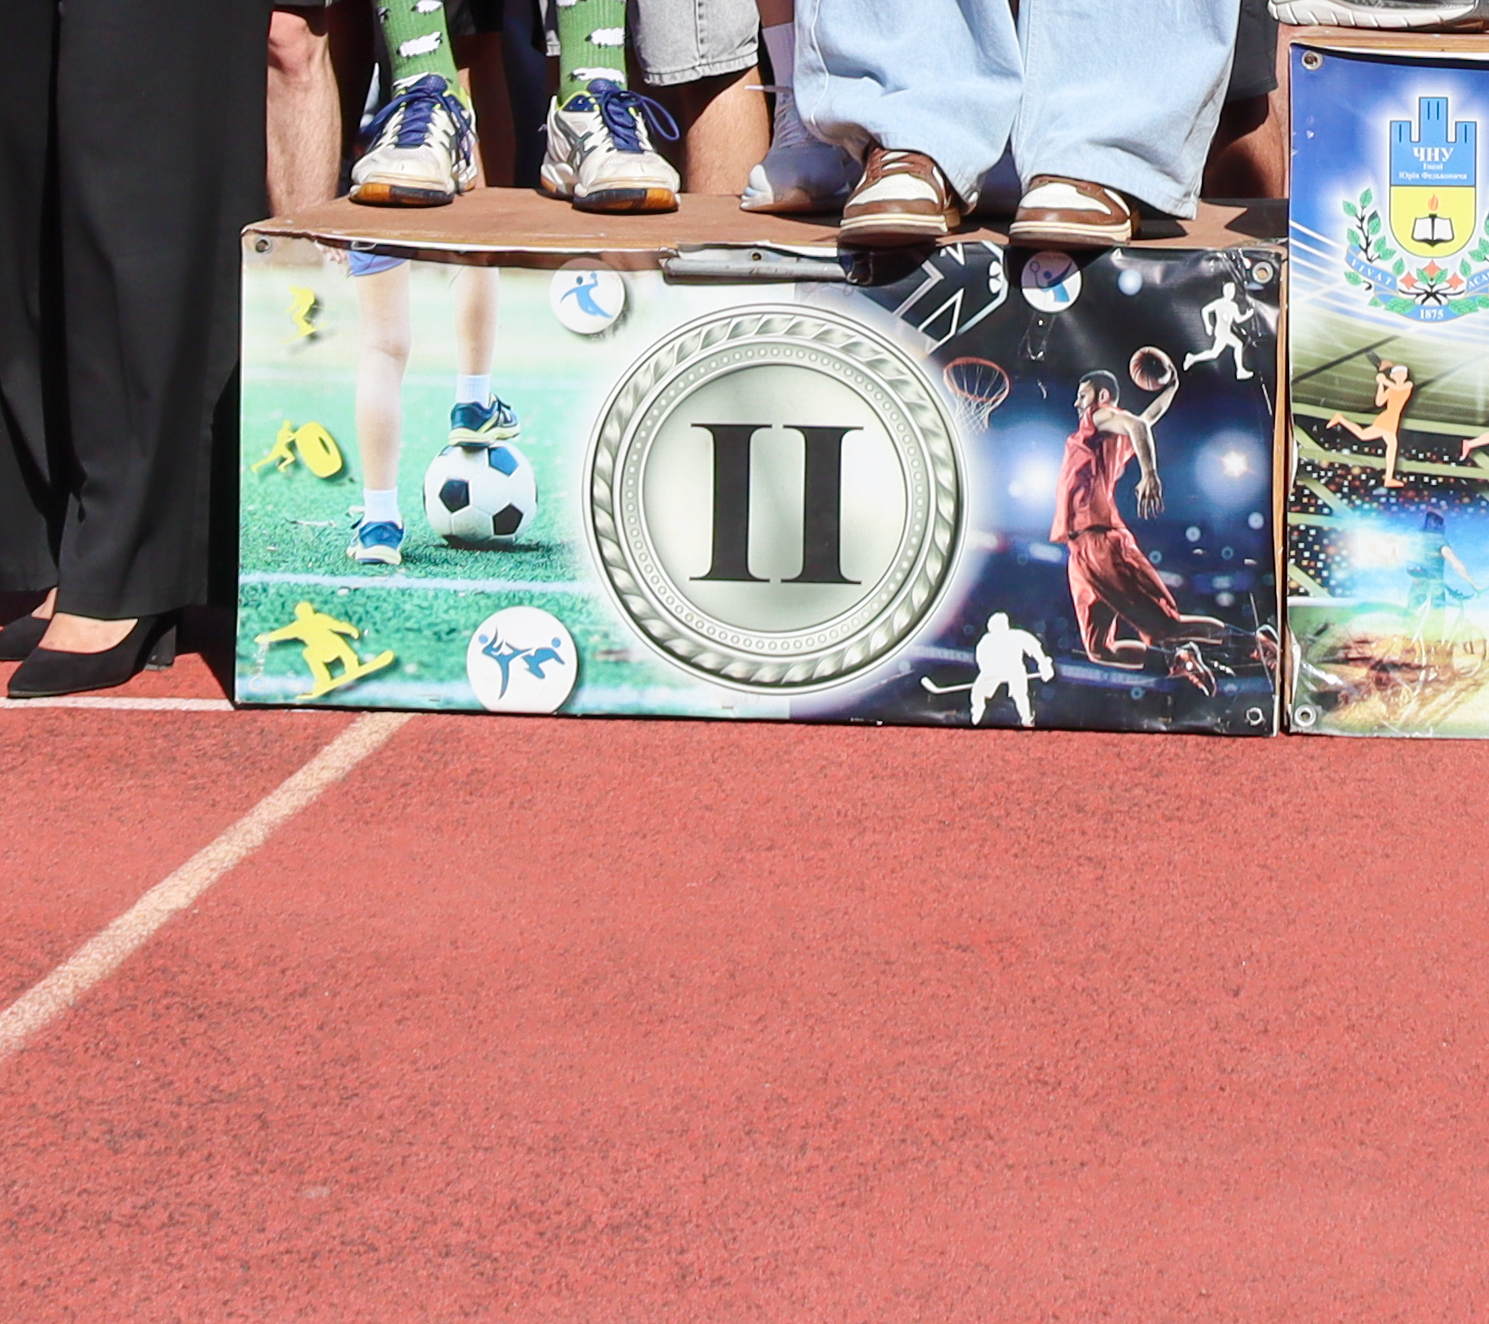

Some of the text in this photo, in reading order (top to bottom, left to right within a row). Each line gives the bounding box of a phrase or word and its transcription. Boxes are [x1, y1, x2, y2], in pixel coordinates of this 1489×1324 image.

[1412, 147, 1454, 162] ЧНУ
[1351, 256, 1393, 286] VIVAT
[1419, 308, 1444, 320] 1875
[687, 423, 865, 585] II
